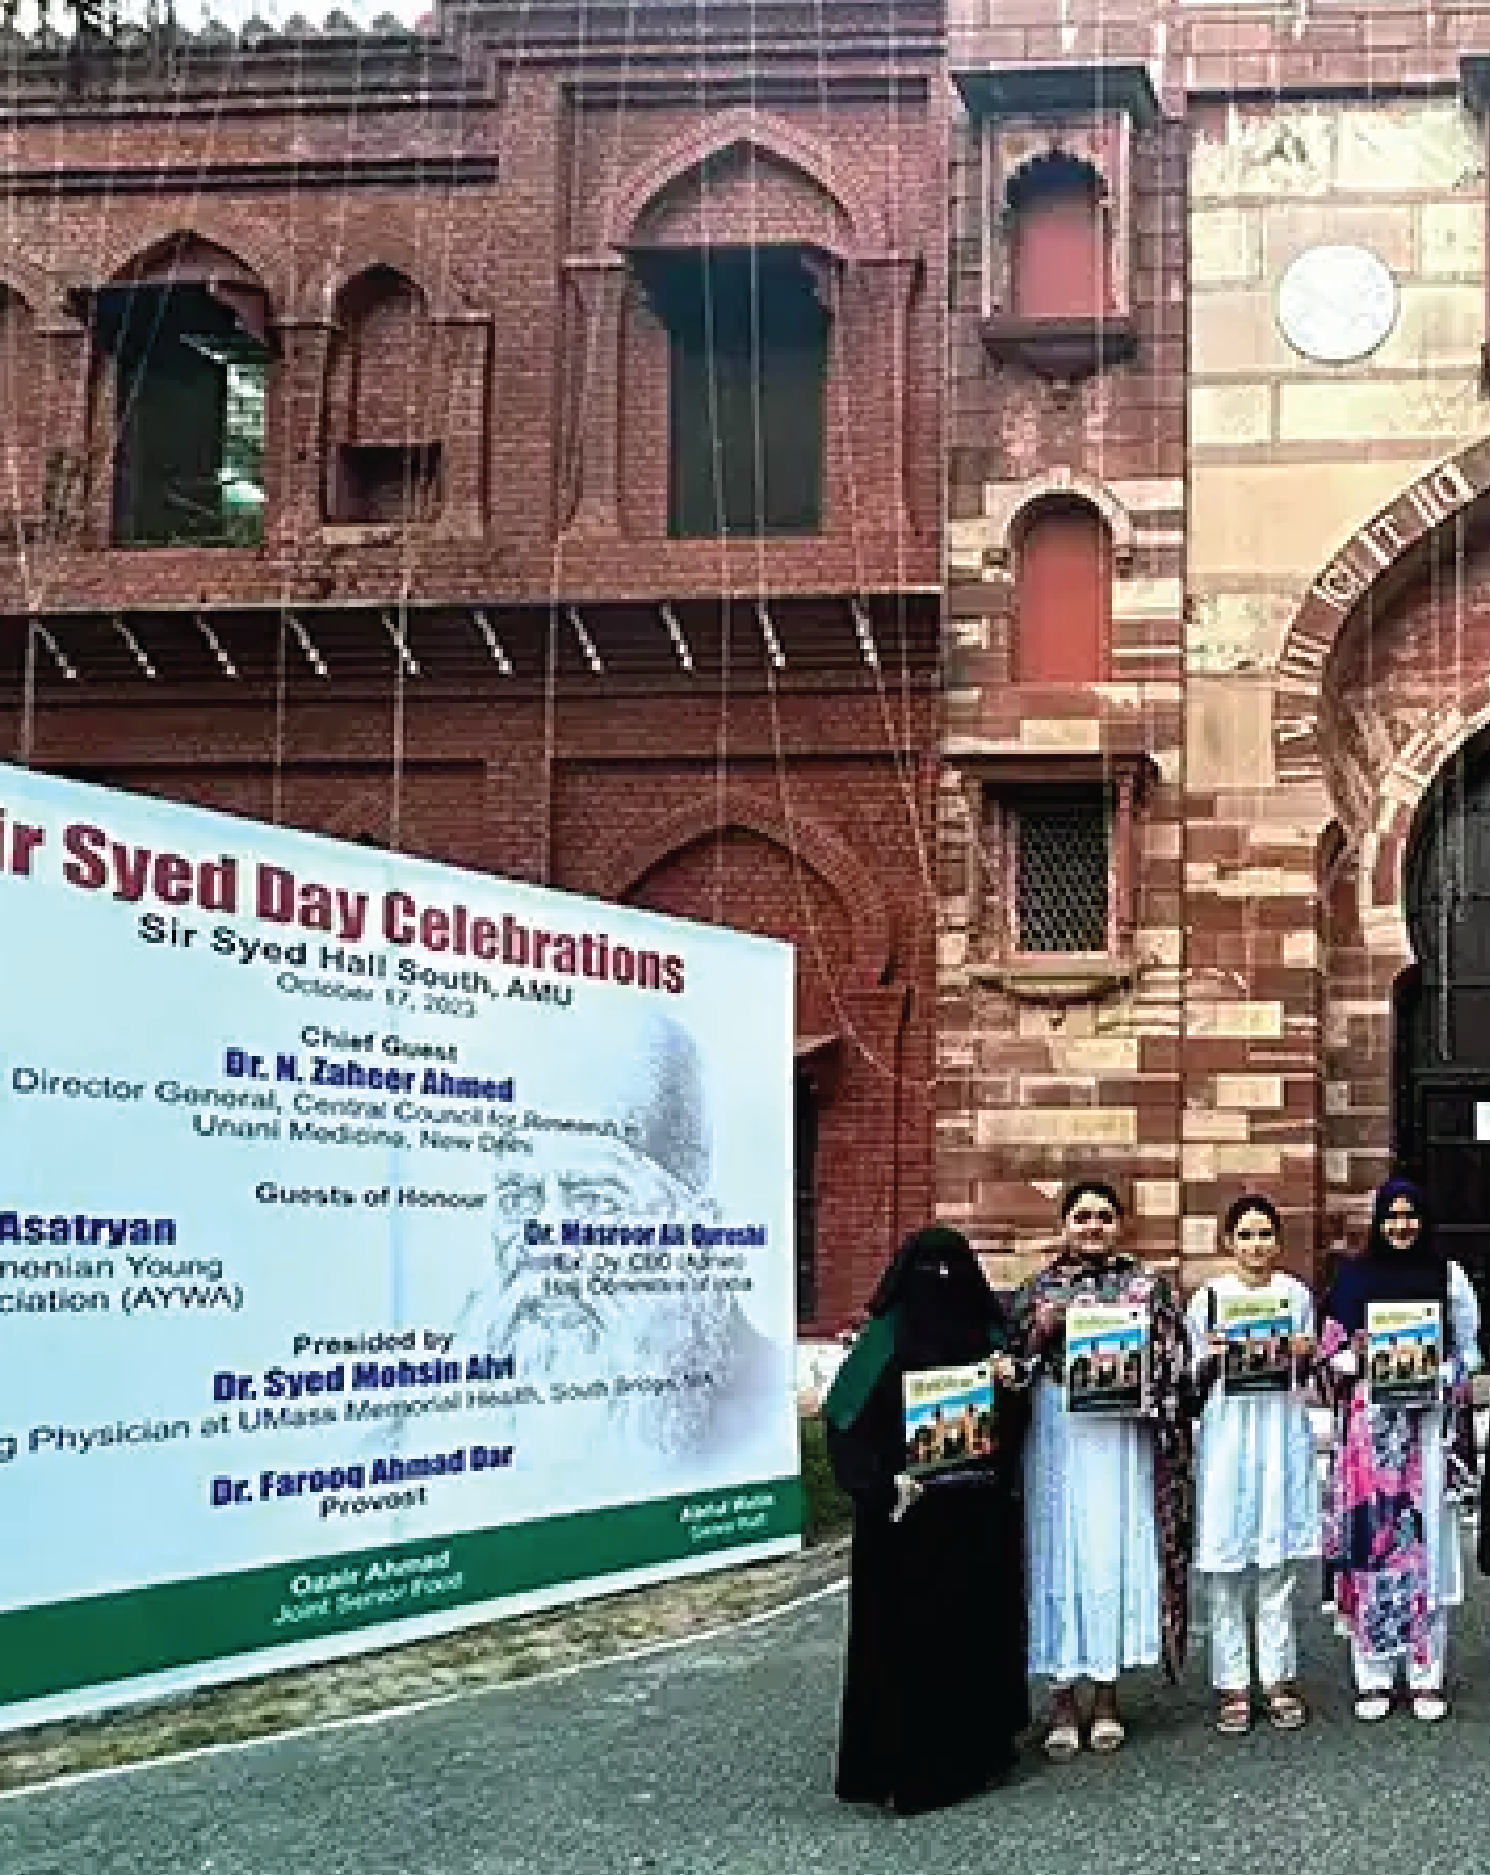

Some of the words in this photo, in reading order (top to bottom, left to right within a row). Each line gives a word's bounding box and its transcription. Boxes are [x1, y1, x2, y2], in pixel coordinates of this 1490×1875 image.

[63, 824, 237, 913] Syed
[256, 862, 369, 940] Day
[382, 889, 684, 993] Celebrations
[138, 912, 198, 947] Sir
[210, 926, 306, 966] Syed
[319, 946, 387, 977] Hall
[503, 975, 573, 1006] AMU
[277, 971, 374, 1000] October
[300, 1025, 374, 1052] Chief
[381, 1034, 458, 1064] Guest
[226, 1047, 269, 1081] Dr.
[275, 1051, 302, 1083] N.
[309, 1055, 416, 1094] Zaheer
[420, 1067, 516, 1103] Ahmed
[12, 1067, 147, 1100] Director
[154, 1080, 283, 1116] General,
[293, 1093, 387, 1120] Central
[392, 1099, 484, 1124] Council
[192, 1114, 282, 1138] Unani
[420, 1130, 472, 1152] New
[255, 1181, 357, 1208] Guests
[363, 1185, 391, 1209] of
[398, 1185, 488, 1209] Honour
[0, 1211, 177, 1249] Asatryan
[125, 1252, 223, 1283] Young
[121, 1285, 245, 1317] (AYWA)
[292, 1328, 416, 1358] Presided
[423, 1327, 458, 1355] by
[213, 1369, 257, 1402] Dr.
[263, 1364, 345, 1399] Syed
[350, 1356, 461, 1393] Mohsin
[28, 1418, 190, 1456] Physician
[200, 1413, 231, 1440] at
[238, 1406, 338, 1433] UMass
[342, 1390, 462, 1422] Memorial
[210, 1473, 253, 1509] Dr.
[259, 1462, 366, 1503] Farooq
[370, 1447, 467, 1486] Ahmad
[469, 1445, 514, 1473] Dar
[318, 1485, 429, 1520] Provost
[289, 1568, 360, 1599] Ozair
[362, 1549, 451, 1582] Ahmad
